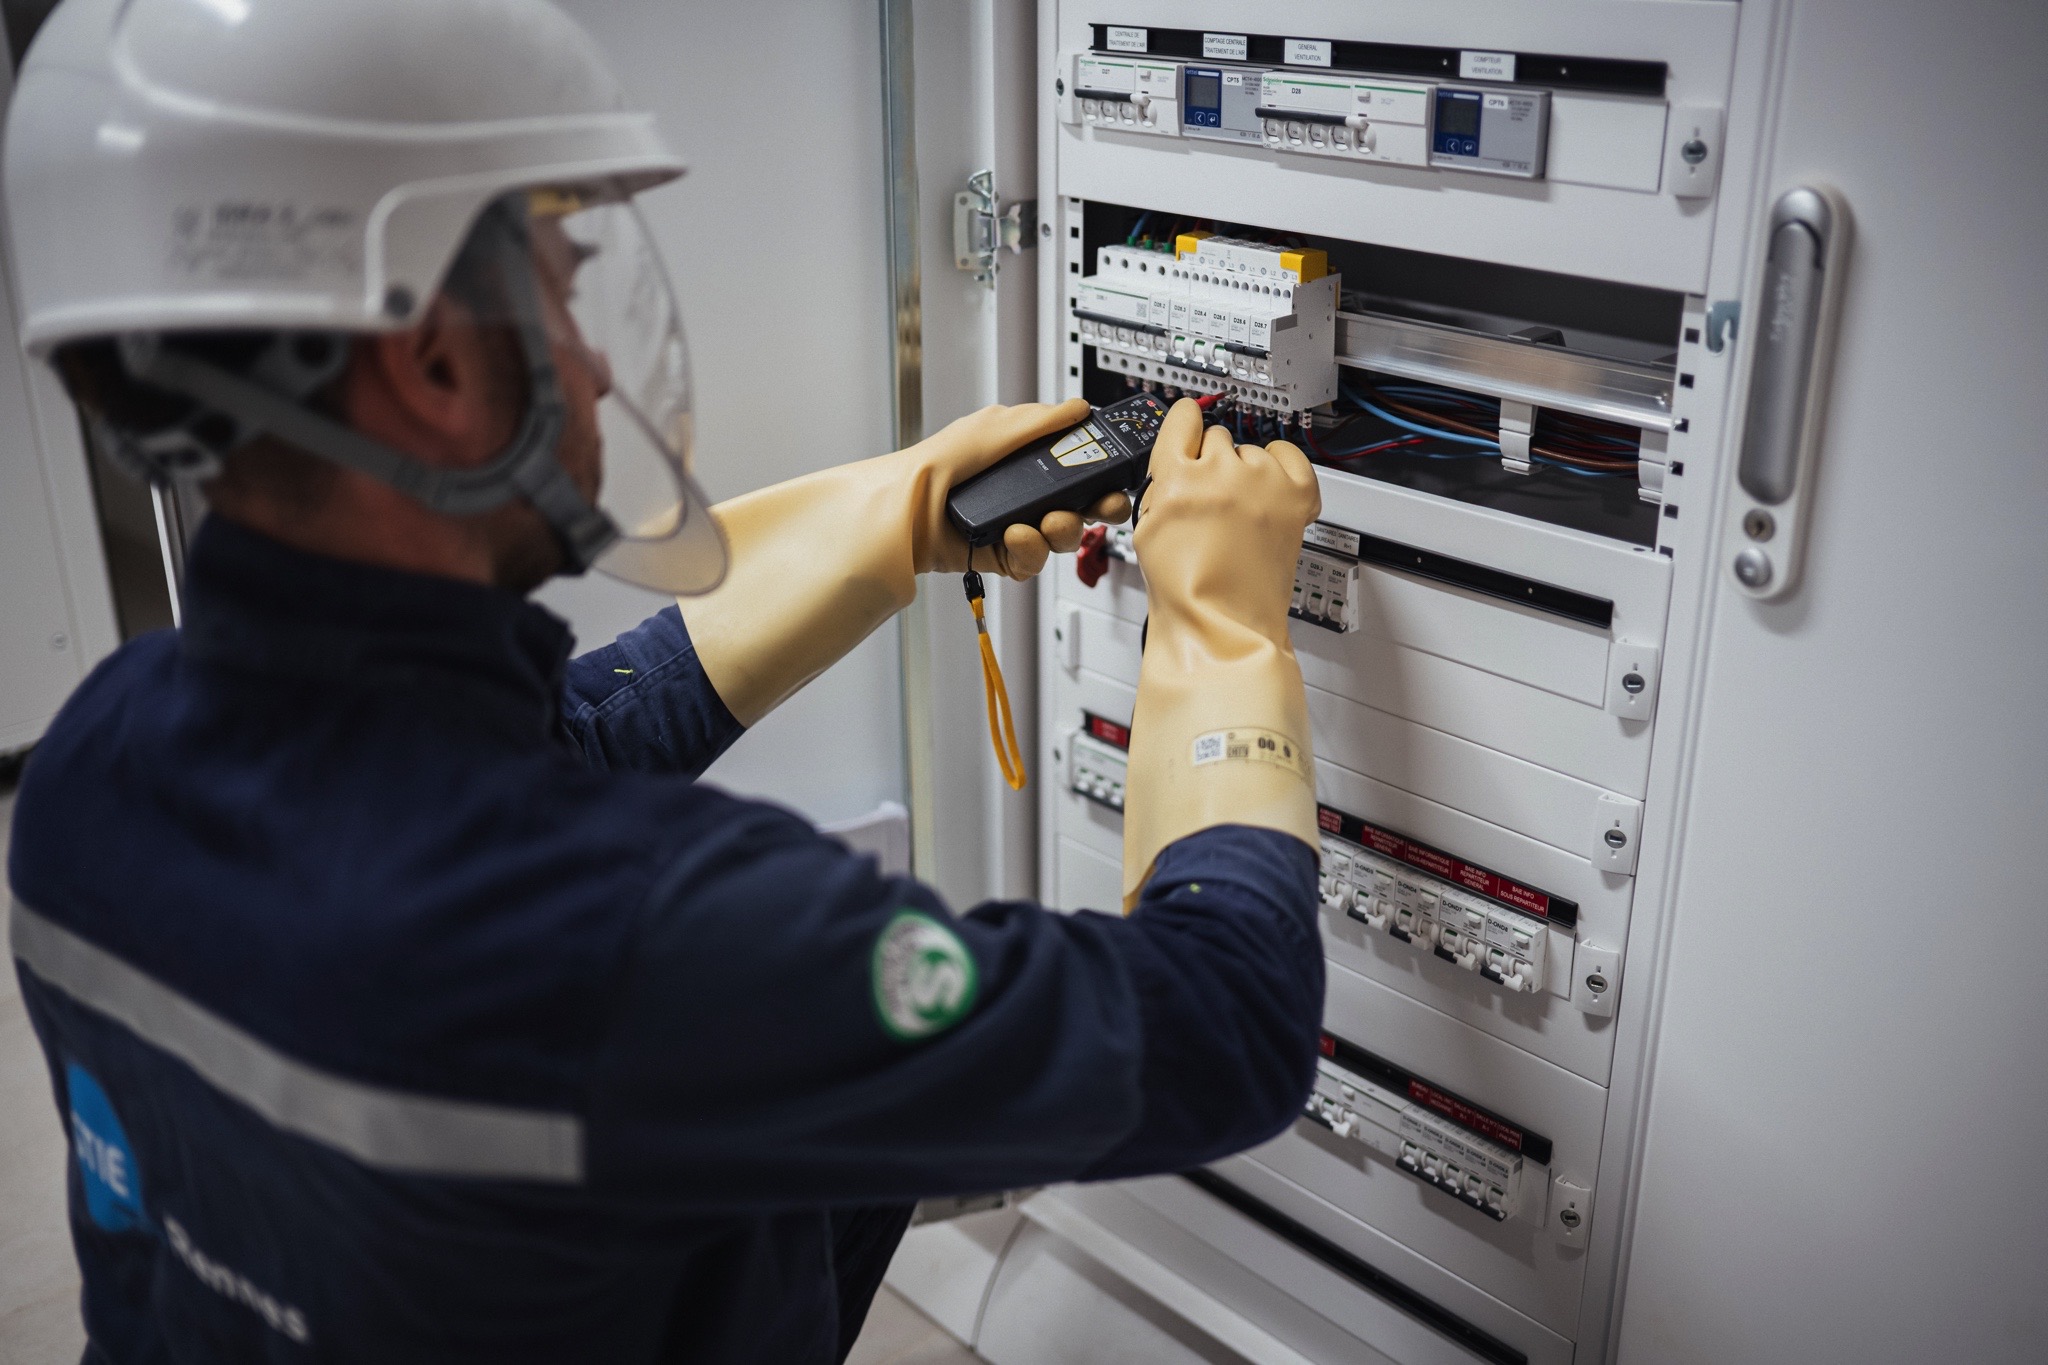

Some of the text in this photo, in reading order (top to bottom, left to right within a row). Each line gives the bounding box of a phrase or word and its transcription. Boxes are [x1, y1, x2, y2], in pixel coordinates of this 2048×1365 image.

[1205, 37, 1246, 46] COMPTAGE CENTRALE
[1205, 47, 1229, 55] TRAITEMENT
[1298, 43, 1317, 51] GENERAL
[1474, 56, 1501, 64] COMPTEUR
[1472, 67, 1502, 75] VENTILATION
[1263, 76, 1282, 85] Schneider
[1317, 527, 1336, 536] SANITAIRES
[1338, 533, 1358, 543] SANITAIRES
[1418, 849, 1449, 866] INFORMATIQUE
[1465, 865, 1475, 873] BAIE
[1460, 870, 1489, 886] REPARTITEUR
[1464, 878, 1484, 891] GENERAL
[1512, 886, 1534, 899] BAIE INFO
[1500, 890, 1544, 913] SOUS REPARTITEUR
